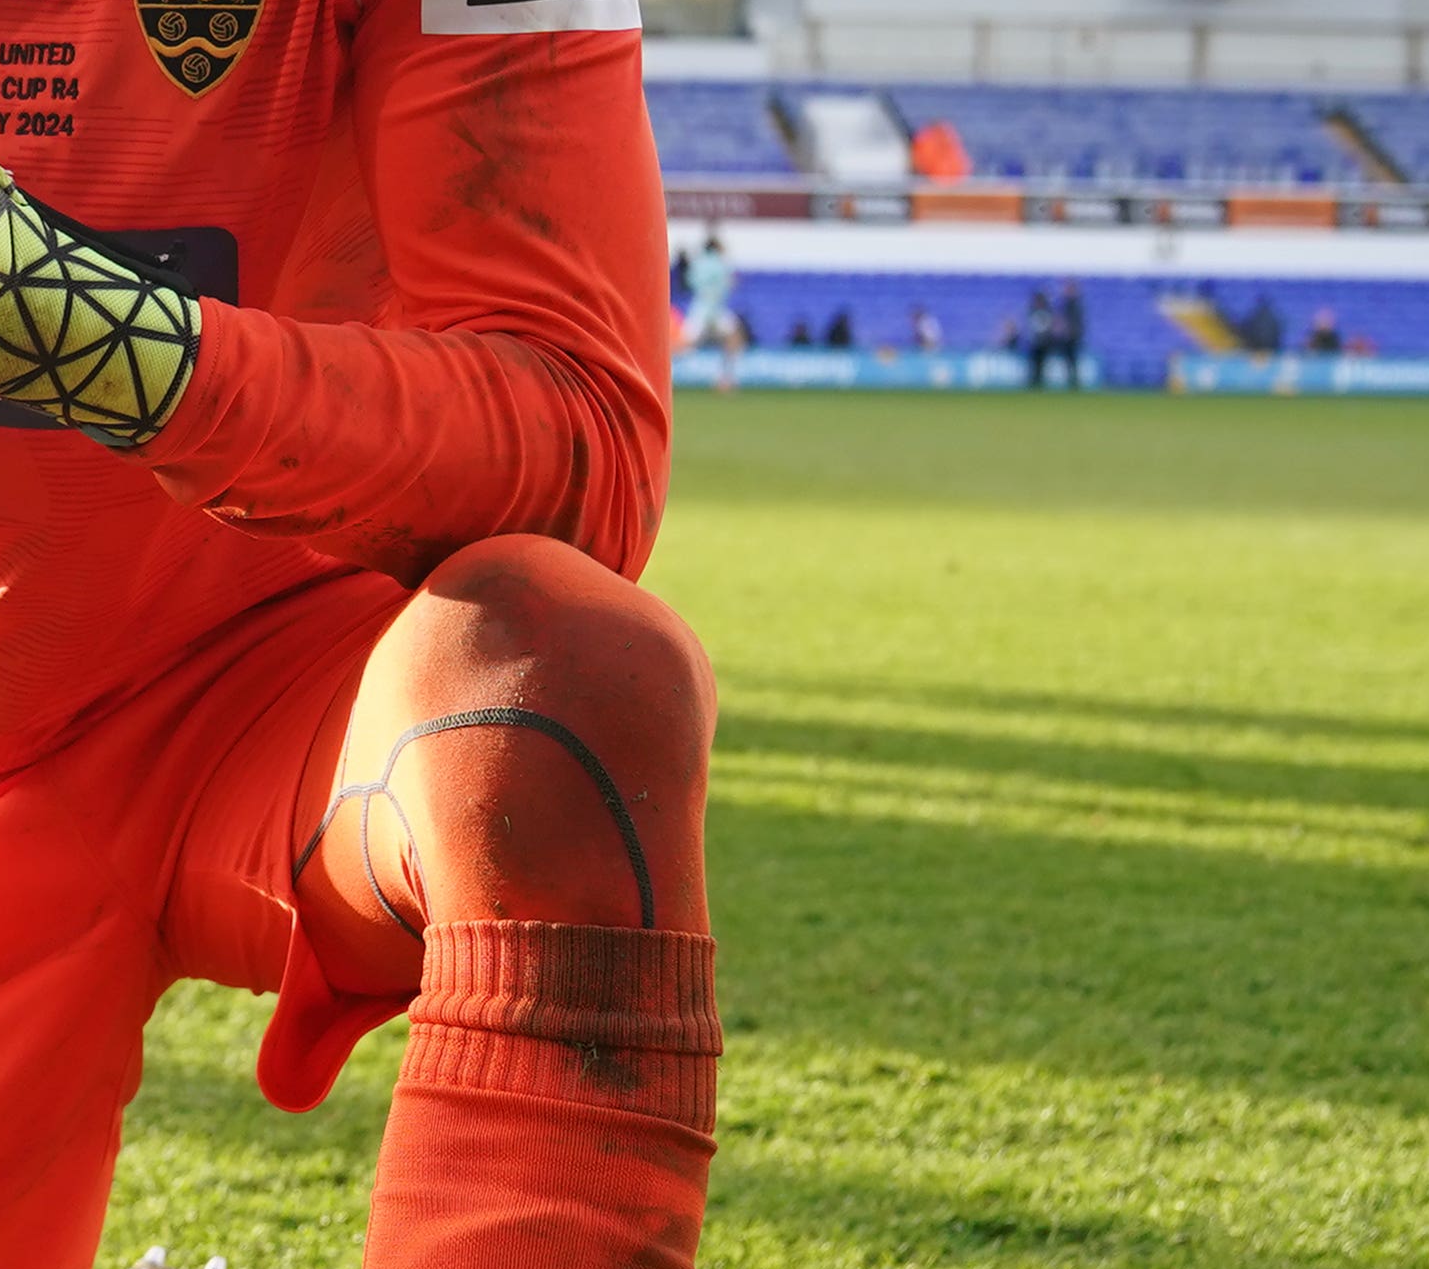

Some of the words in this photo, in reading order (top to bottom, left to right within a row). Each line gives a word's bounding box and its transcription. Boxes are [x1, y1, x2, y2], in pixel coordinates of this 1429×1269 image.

[1, 76, 48, 101] CUP
[51, 77, 80, 101] R4
[14, 112, 75, 137] 2024
